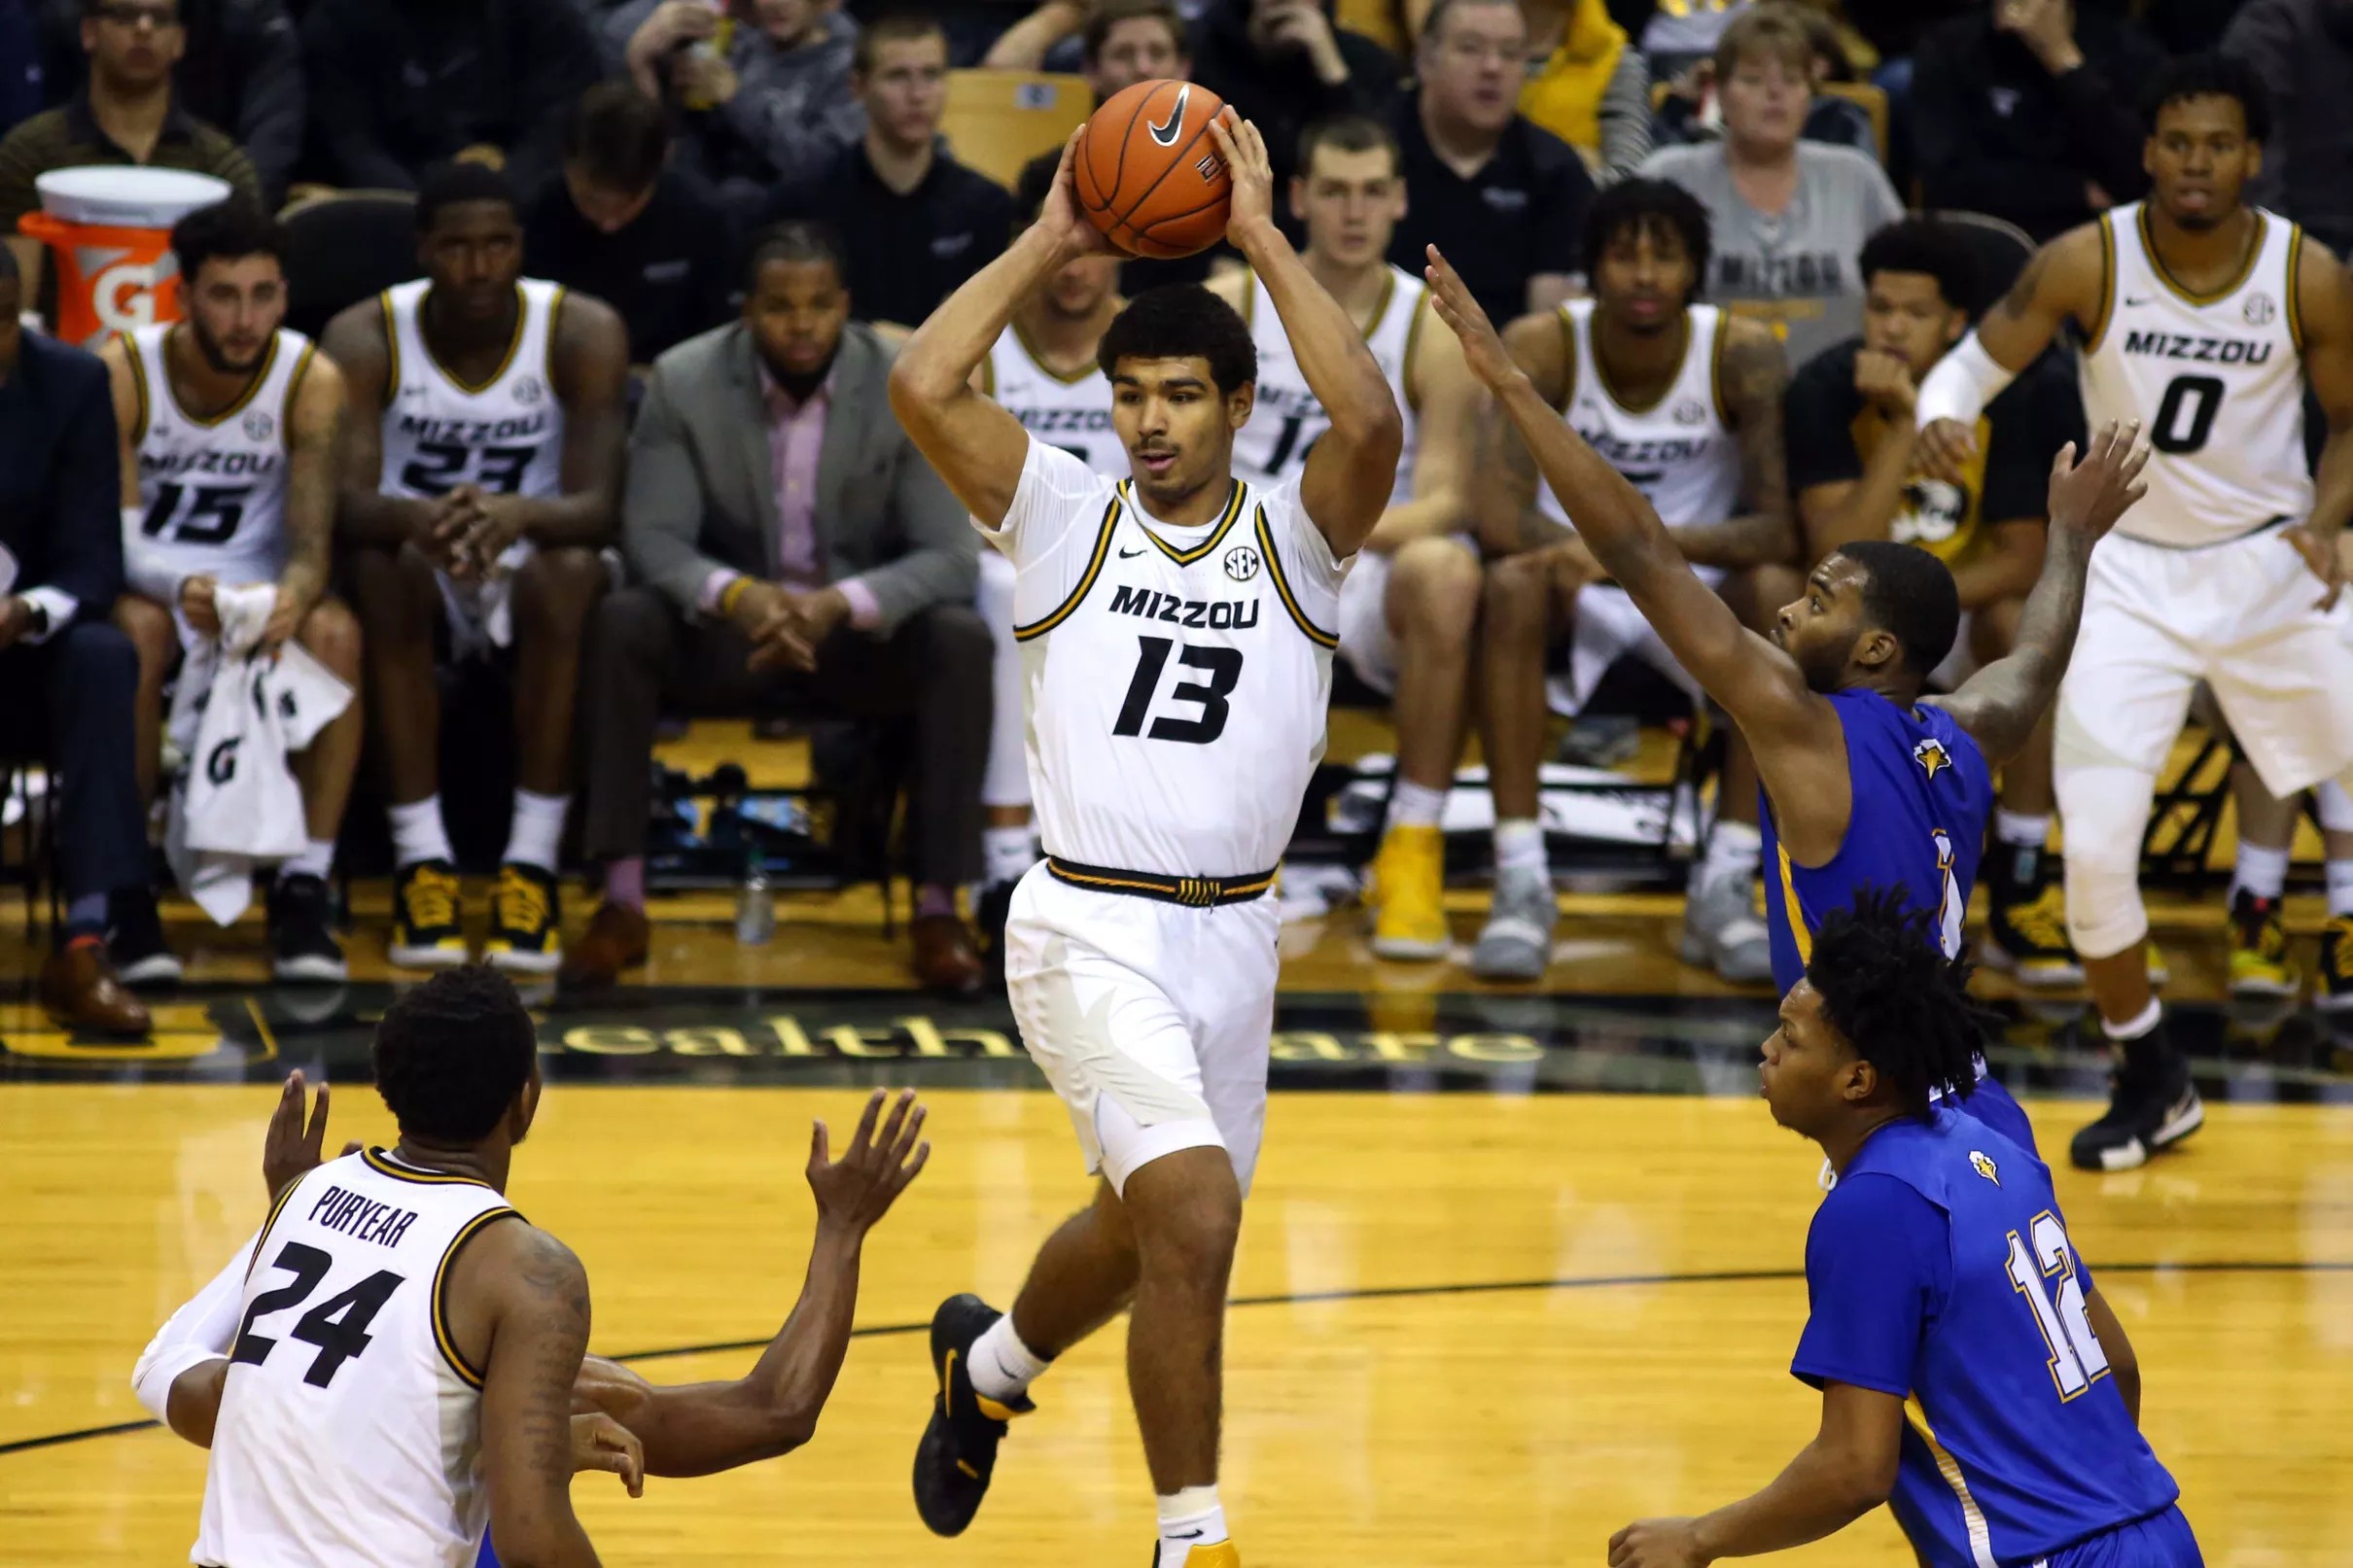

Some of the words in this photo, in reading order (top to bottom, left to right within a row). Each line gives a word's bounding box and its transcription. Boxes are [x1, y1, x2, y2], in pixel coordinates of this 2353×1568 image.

[93, 264, 155, 331] G
[2124, 331, 2272, 366] MIZZOU
[400, 414, 545, 443] MIZZOU
[2151, 374, 2226, 454] 0
[140, 448, 276, 475] MIZZOU
[401, 441, 538, 498] 23
[141, 482, 258, 545] 15
[1224, 546, 1259, 581] SEC
[1108, 585, 1259, 630] MIZZOU
[1112, 635, 1245, 745] 13
[539, 1012, 1031, 1059] ealth
[1268, 1030, 1547, 1062] are
[308, 1185, 419, 1248] PURYEAR
[230, 1240, 406, 1389] 24
[2005, 1209, 2112, 1404] 12
